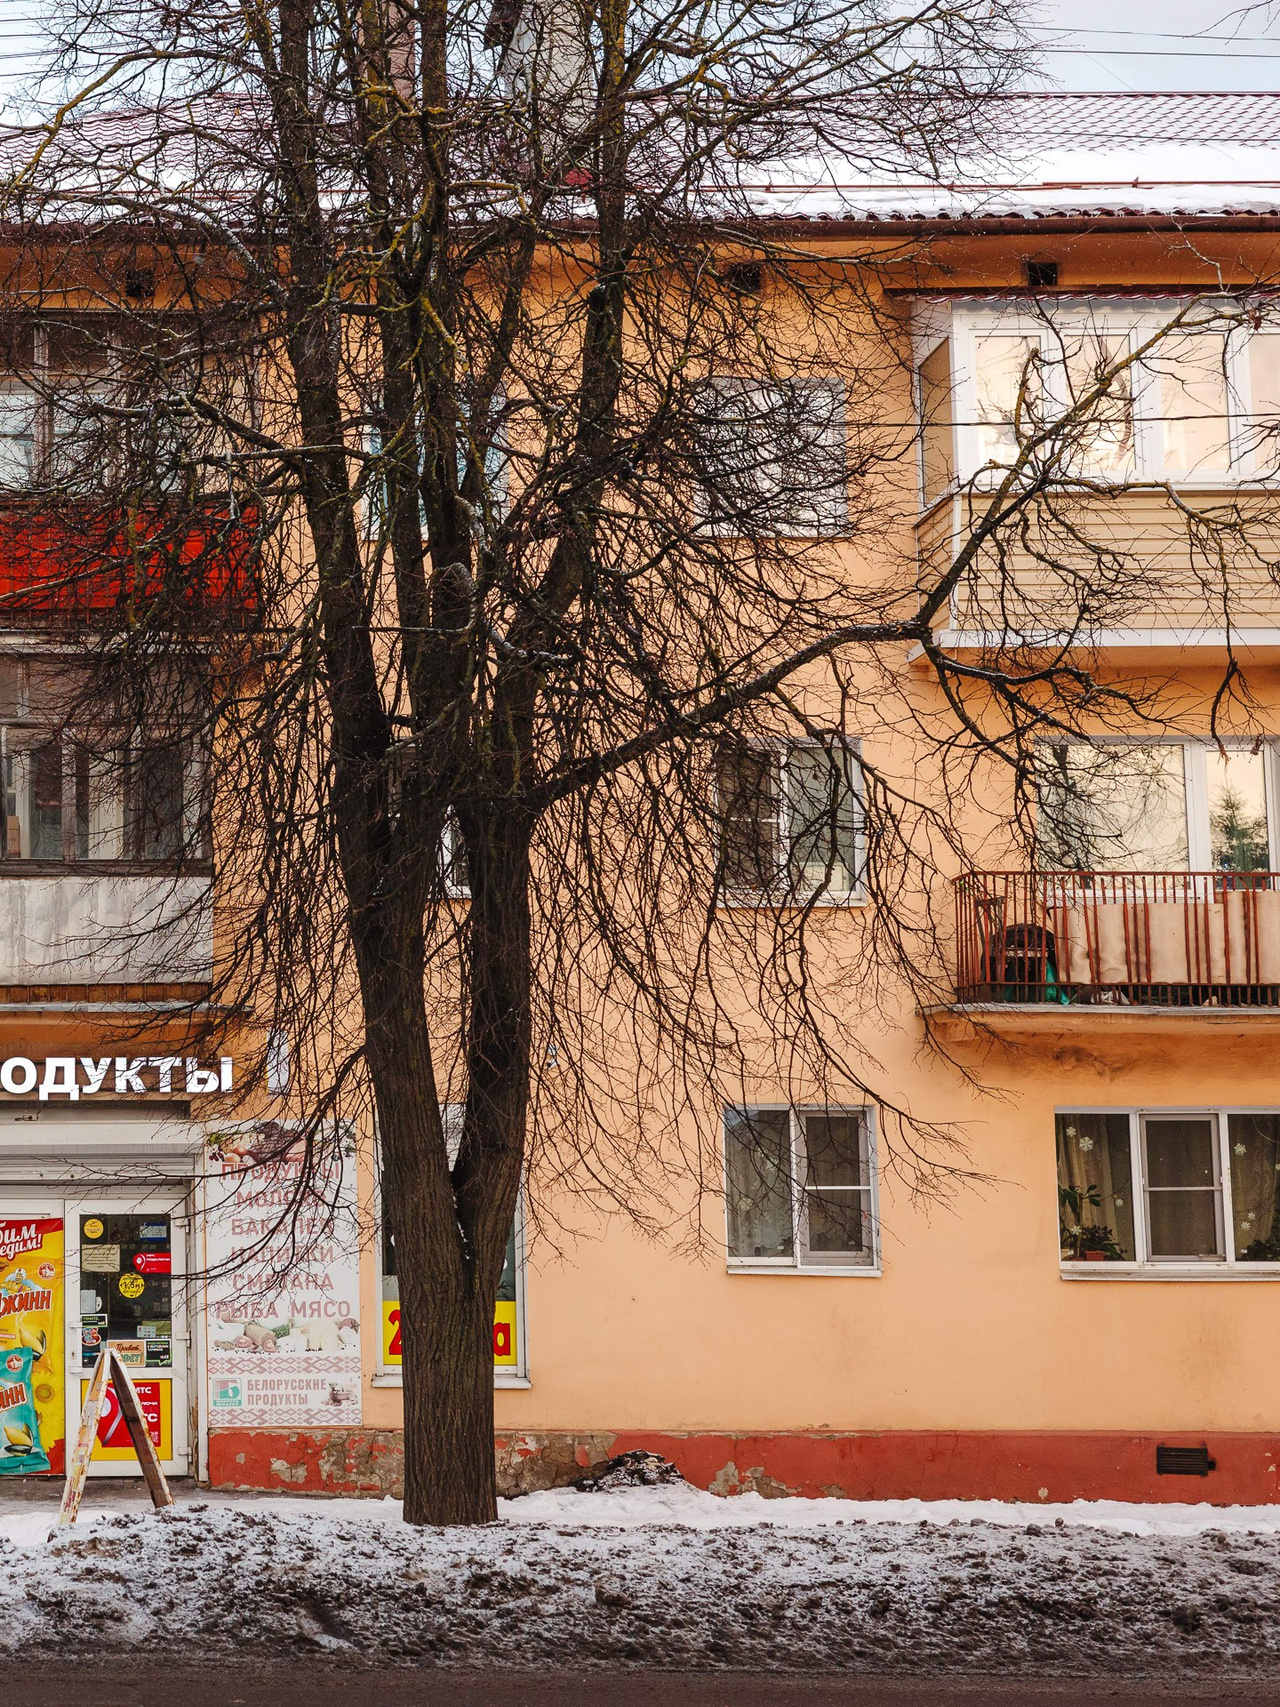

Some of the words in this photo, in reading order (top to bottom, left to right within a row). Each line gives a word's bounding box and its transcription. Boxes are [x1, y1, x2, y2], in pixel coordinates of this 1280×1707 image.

[221, 1162, 340, 1183] ПРОДУКЫ
[0, 1234, 42, 1260] едим!
[290, 1300, 351, 1319] МЯСО
[247, 1379, 326, 1391] БЕЛОРУССКИЕ
[247, 1393, 308, 1407] ПРОДУКТЫ
